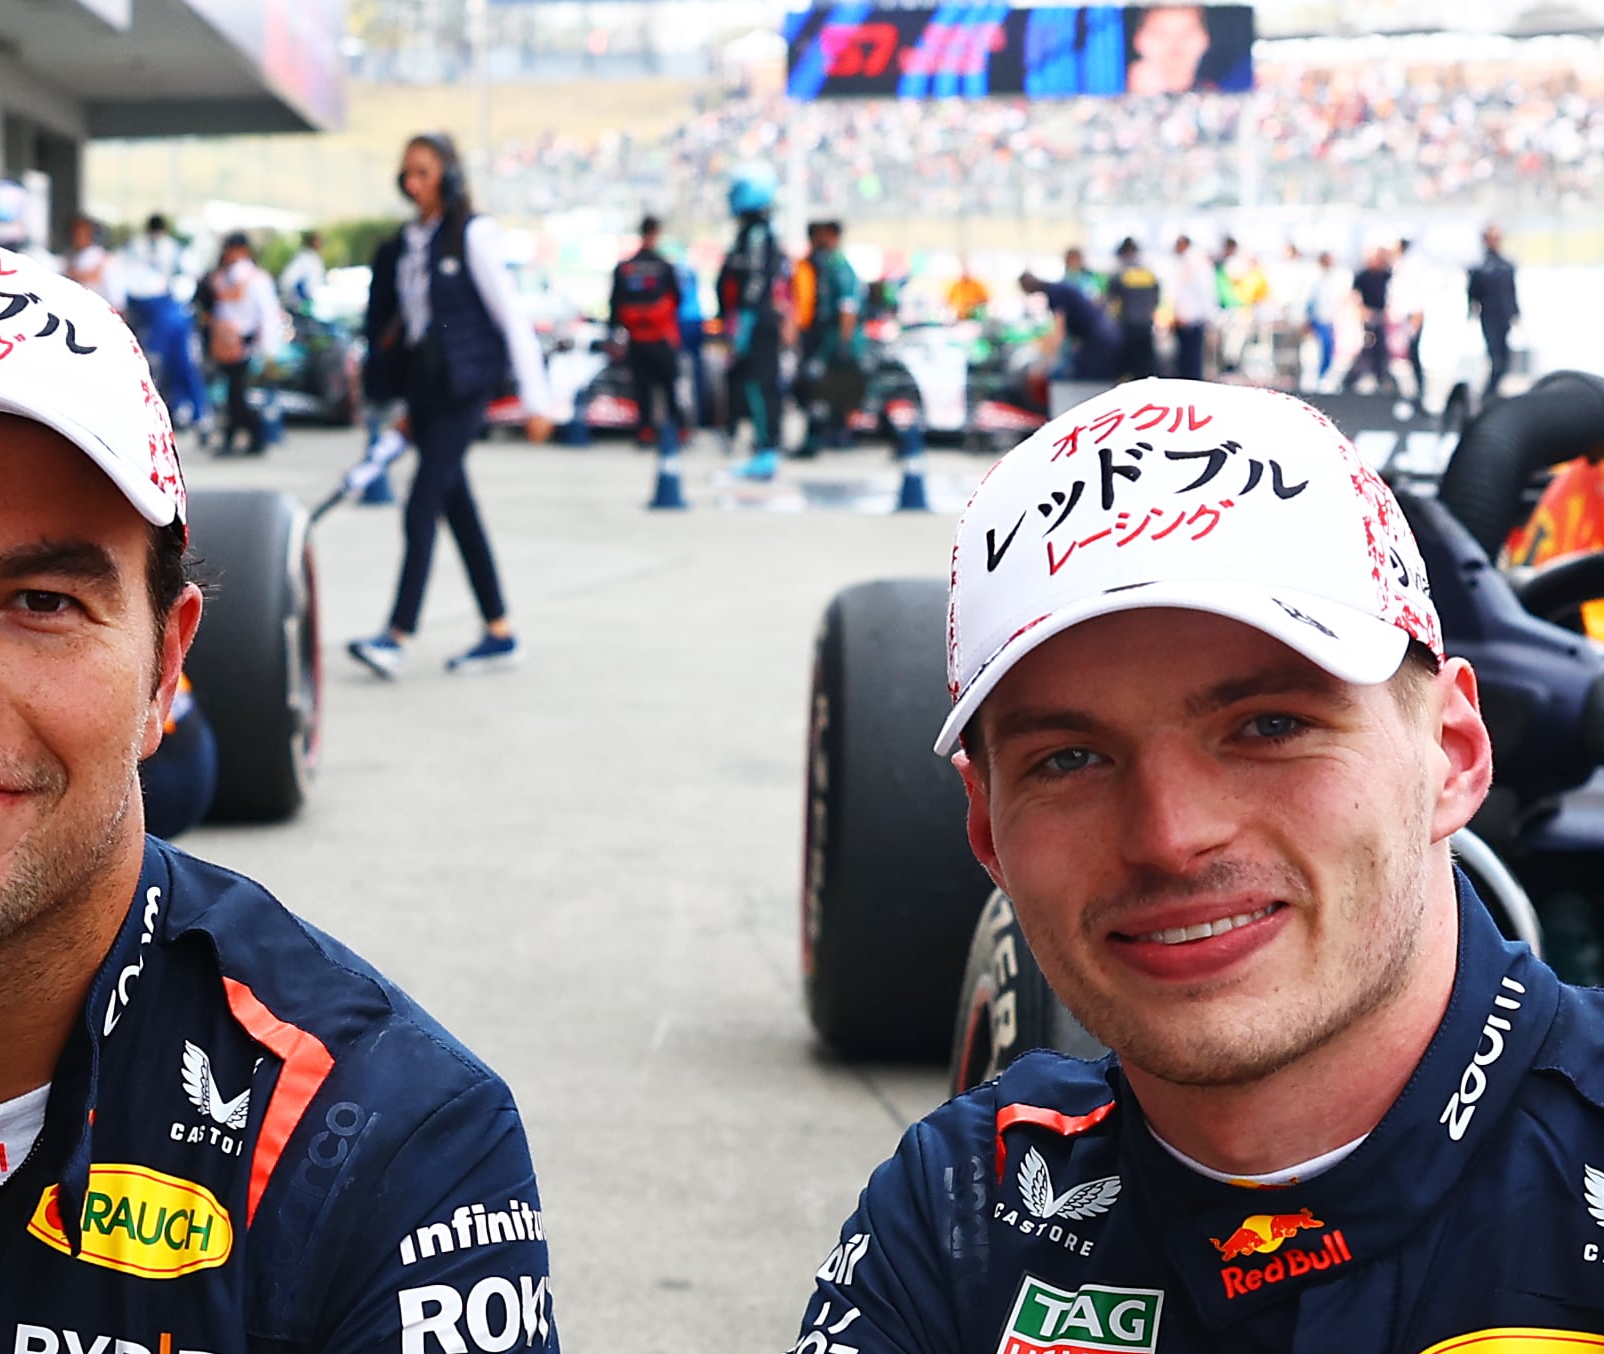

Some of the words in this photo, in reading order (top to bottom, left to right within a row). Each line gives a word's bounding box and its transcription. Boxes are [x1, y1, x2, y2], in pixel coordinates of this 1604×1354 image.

[1050, 403, 1213, 462] オラクル
[985, 440, 1311, 573] レッドブル
[1047, 498, 1236, 576] レーシング
[169, 1121, 244, 1157] CASTO
[82, 1191, 214, 1252] RAUCH
[399, 1199, 547, 1266] infinitu
[994, 1200, 1094, 1257] CASTORE
[1219, 1255, 1286, 1300] Red
[1284, 1230, 1352, 1278] Bull
[1034, 1293, 1147, 1341] TAG
